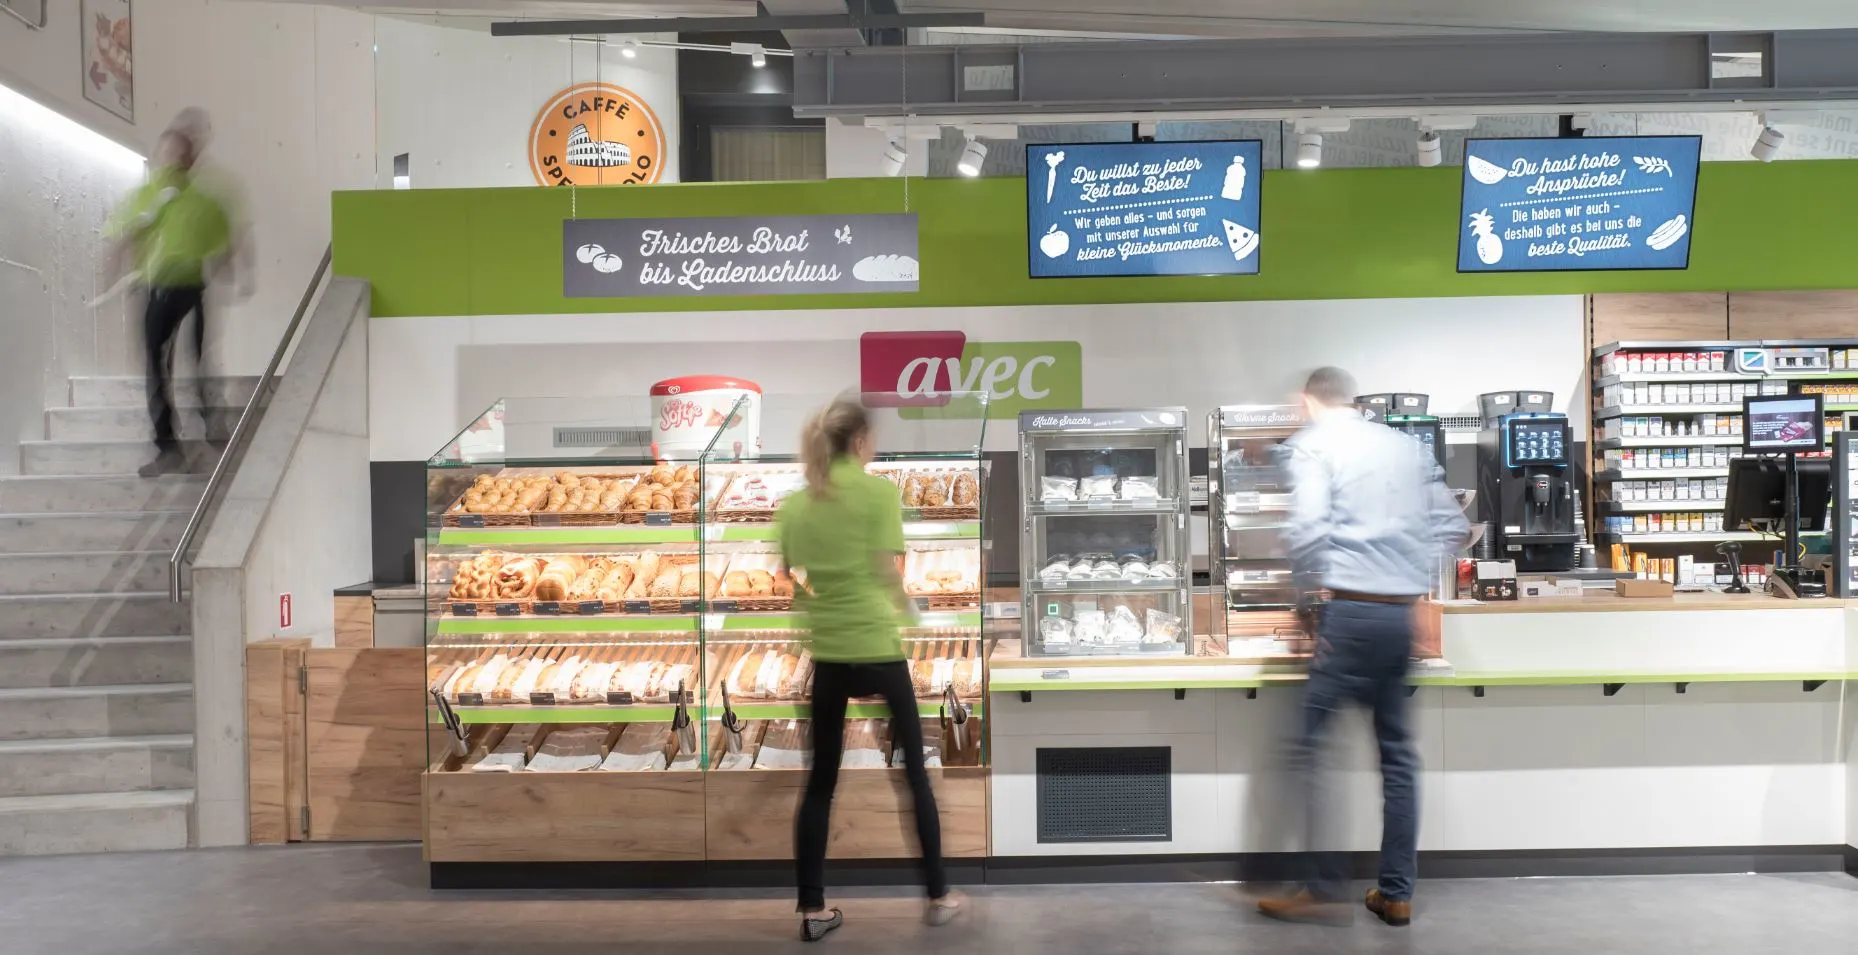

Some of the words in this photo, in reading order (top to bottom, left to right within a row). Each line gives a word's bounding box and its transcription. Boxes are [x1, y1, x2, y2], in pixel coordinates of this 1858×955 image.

[562, 97, 631, 120] CAFFÈ
[1071, 166, 1098, 184] Du
[1099, 162, 1140, 181] willst
[1143, 163, 1161, 176] zu
[1161, 157, 1203, 179] jeder
[1508, 157, 1539, 178] Du
[1539, 154, 1578, 174] hast
[1578, 151, 1621, 170] hohe
[1080, 181, 1111, 203] Zeit
[1113, 180, 1140, 196] das
[1142, 174, 1191, 194] Beste!
[1526, 168, 1627, 195] Ansprüche!
[1075, 217, 1093, 230] Wir
[1094, 214, 1121, 230] geben
[1123, 211, 1145, 225] alles
[1156, 207, 1173, 221] und
[1176, 206, 1206, 220] sorgen
[1512, 209, 1529, 223] Die
[1531, 206, 1561, 221] haben
[1565, 204, 1582, 217] wir
[1585, 202, 1610, 215] auch
[639, 228, 744, 258] Frisches
[746, 225, 810, 254] Brot
[1086, 231, 1103, 244] mit
[1105, 228, 1140, 242] unserer
[1143, 222, 1181, 238] Auswahl
[1183, 221, 1199, 234] für
[1504, 224, 1543, 241] deshalb
[1546, 221, 1567, 238] gibt
[1570, 223, 1583, 234] es
[1586, 218, 1602, 232] bei
[1604, 217, 1624, 231] uns
[1627, 215, 1642, 229] die
[1076, 246, 1117, 261] kleine
[1117, 234, 1224, 261] Glücksmomente.
[1527, 240, 1566, 257] beste
[1566, 232, 1632, 257] Qualität.
[639, 262, 676, 286] bis
[677, 258, 842, 291] Ladenschluss
[896, 354, 1055, 400] avec
[1059, 414, 1092, 427] Snacks
